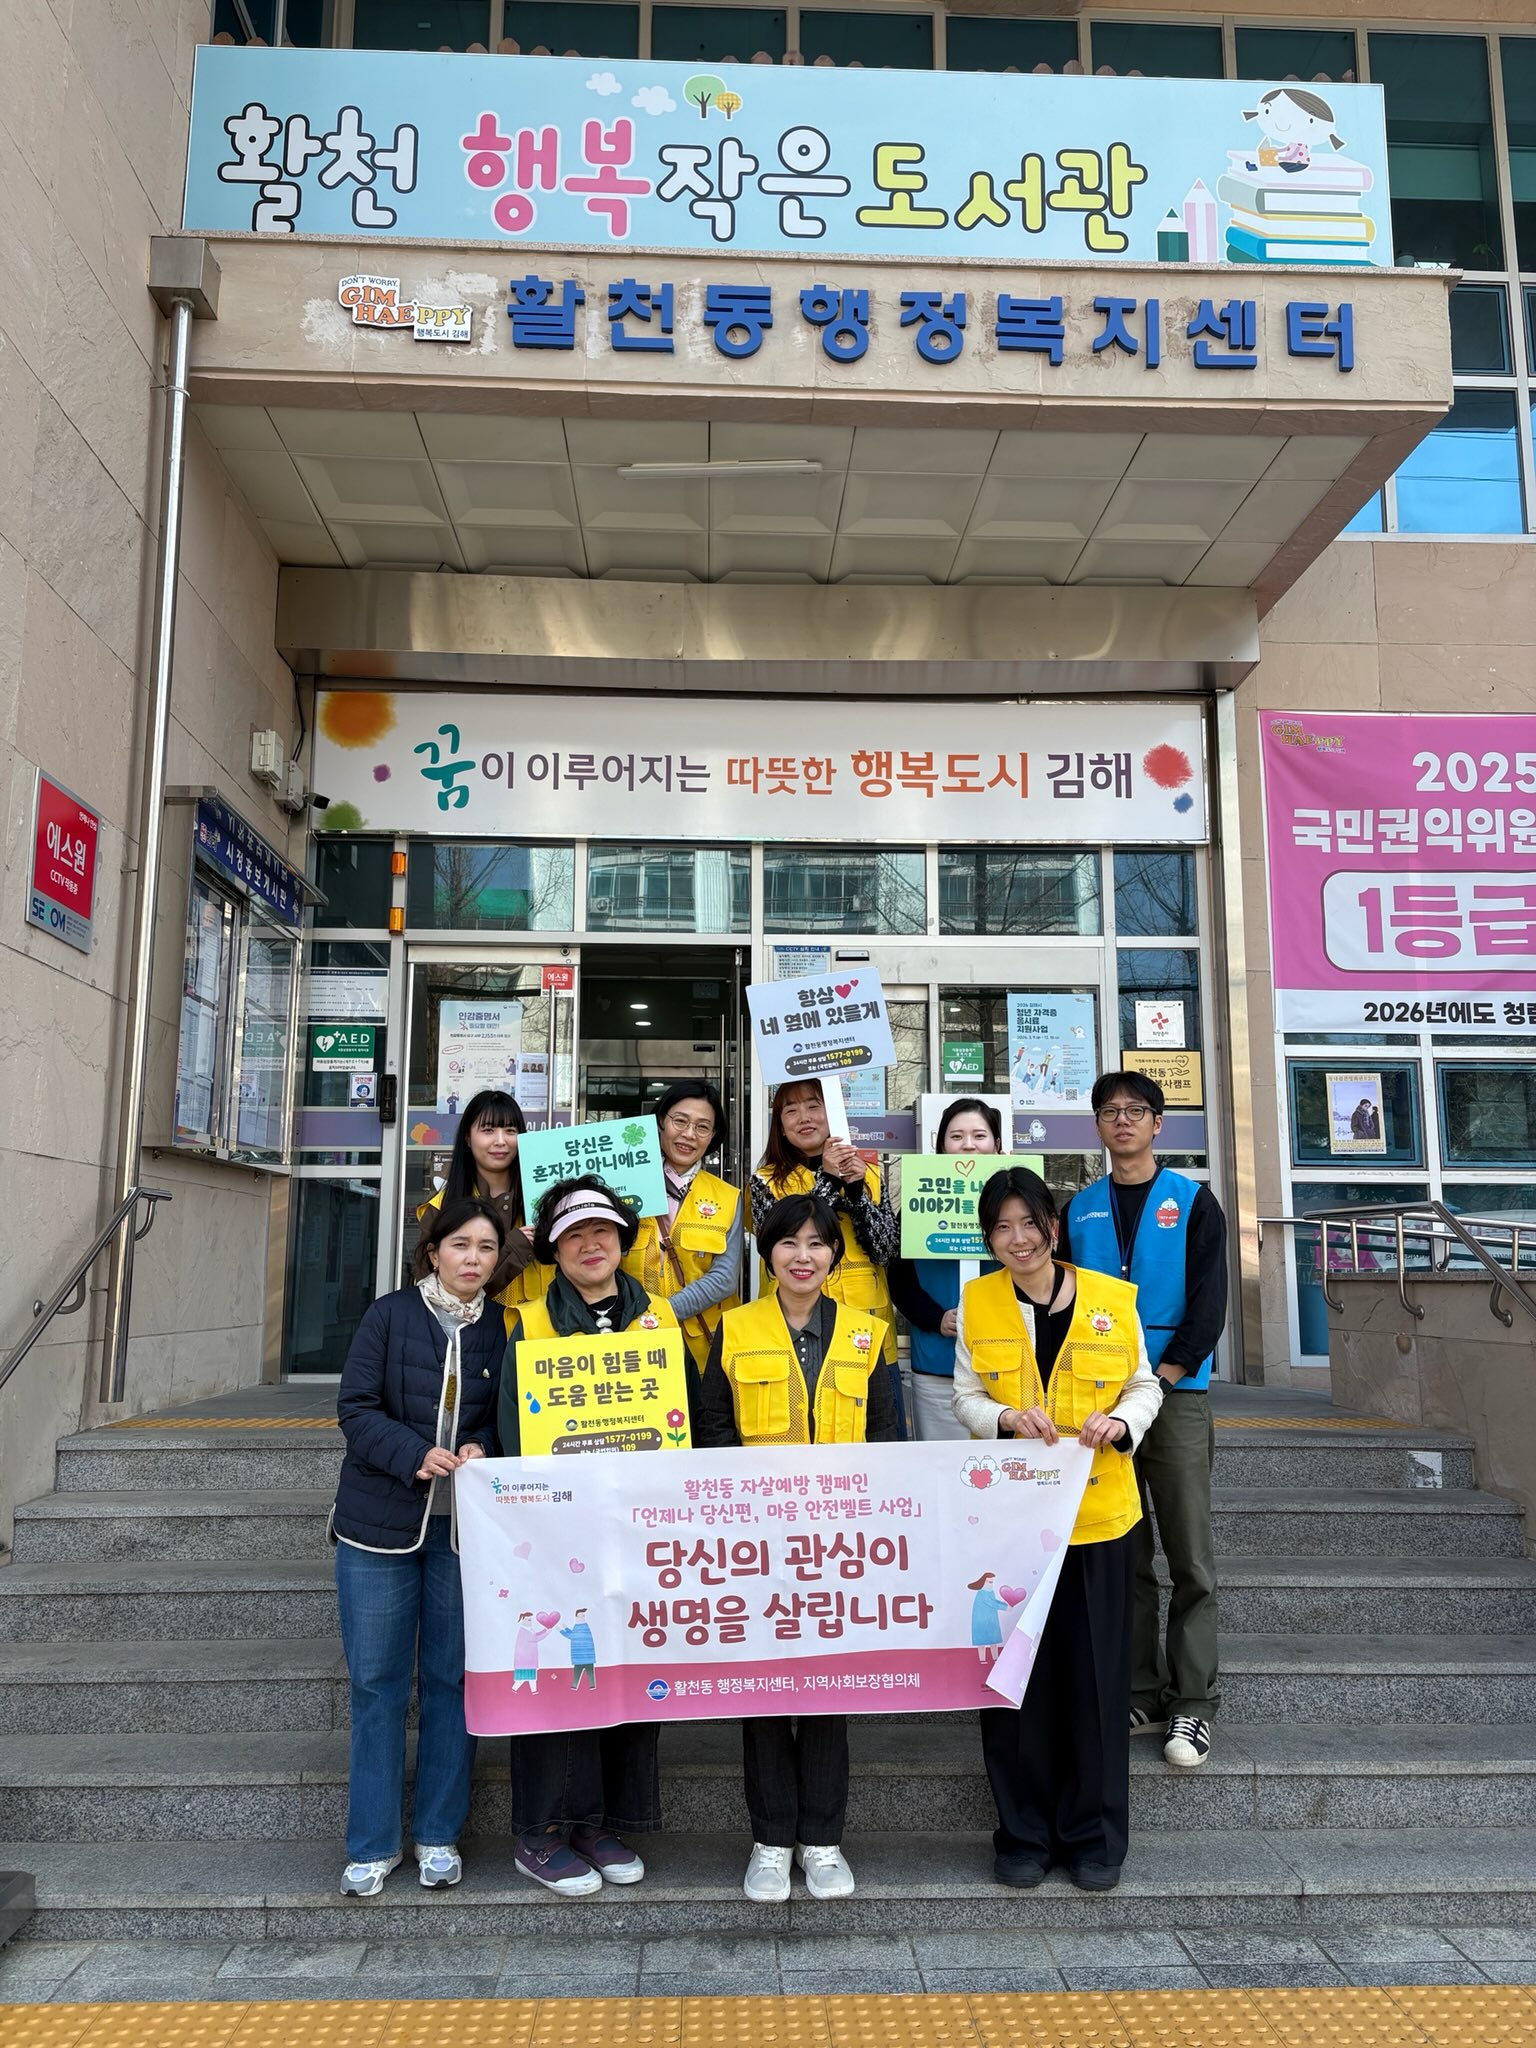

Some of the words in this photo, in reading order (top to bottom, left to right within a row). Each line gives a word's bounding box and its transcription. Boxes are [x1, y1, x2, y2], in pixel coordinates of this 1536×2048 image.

[218, 102, 418, 232] 활천
[341, 277, 365, 287] DON'T
[341, 285, 396, 307] GIM
[417, 328, 449, 338] 행복도시
[452, 330, 468, 338] 김해
[507, 274, 1355, 372] 활천동행정복지센터
[414, 724, 515, 811] 꿈이
[527, 752, 711, 792] 이루어지는
[727, 756, 837, 795] 따뜻한
[851, 750, 1028, 799] 행복도시
[1046, 752, 1132, 799] 김해
[1412, 752, 1536, 793] 2025
[46, 821, 86, 877] 에스원
[50, 869, 65, 886] CCTV
[226, 841, 287, 910] 시정홍보게시판
[1358, 884, 1536, 958] 1등급
[547, 973, 568, 981] 에스원
[797, 986, 835, 1008] 항상
[458, 1012, 500, 1020] 인감증명서
[760, 1016, 780, 1036] 네
[784, 1009, 821, 1033] 옆에
[825, 1001, 881, 1026] 있을게
[1017, 1009, 1031, 1017] 청년
[1034, 1009, 1057, 1017] 자격증
[1017, 1017, 1039, 1025] 응시료
[1364, 1002, 1496, 1024] 2026년에도
[339, 1033, 370, 1043] AED
[1017, 1025, 1048, 1033] 지원사업
[826, 1049, 863, 1060] 1577-0199
[565, 1135, 613, 1157] 당신은
[532, 1159, 581, 1183] 혼자가
[585, 1150, 650, 1173] 아니에요
[917, 1177, 966, 1194] 고민을
[909, 1197, 975, 1214] 이야기를
[535, 1354, 595, 1379] 마음이
[601, 1350, 642, 1375] 힘들
[647, 1348, 667, 1369] 때
[547, 1385, 588, 1408] 도움
[594, 1381, 634, 1405] 받는
[640, 1378, 659, 1400] 곳
[580, 1415, 645, 1429] 활천동행정복지센터
[594, 1438, 605, 1446] 상담
[605, 1431, 652, 1444] 1577-0199
[1002, 1462, 1026, 1472] GIM
[496, 1495, 518, 1504] 따뜻한
[520, 1495, 550, 1503] 행복도시
[552, 1490, 573, 1502] 김해
[512, 1483, 549, 1492] 이루어지는
[684, 1478, 734, 1500] 활천동
[741, 1475, 810, 1498] 자살예방
[816, 1473, 868, 1494] 캠페인
[701, 1502, 759, 1525] 당신편,
[766, 1501, 799, 1522] 마음
[805, 1498, 872, 1521] 안전벨트
[646, 1538, 770, 1589] 당신의
[785, 1532, 908, 1581] 관심이
[627, 1595, 749, 1648] 생명을
[763, 1591, 934, 1640] 살립니다
[674, 1679, 713, 1696] 활천동
[717, 1675, 799, 1694] 행정복지센터,
[803, 1672, 920, 1692] 지역사회보장협의체
